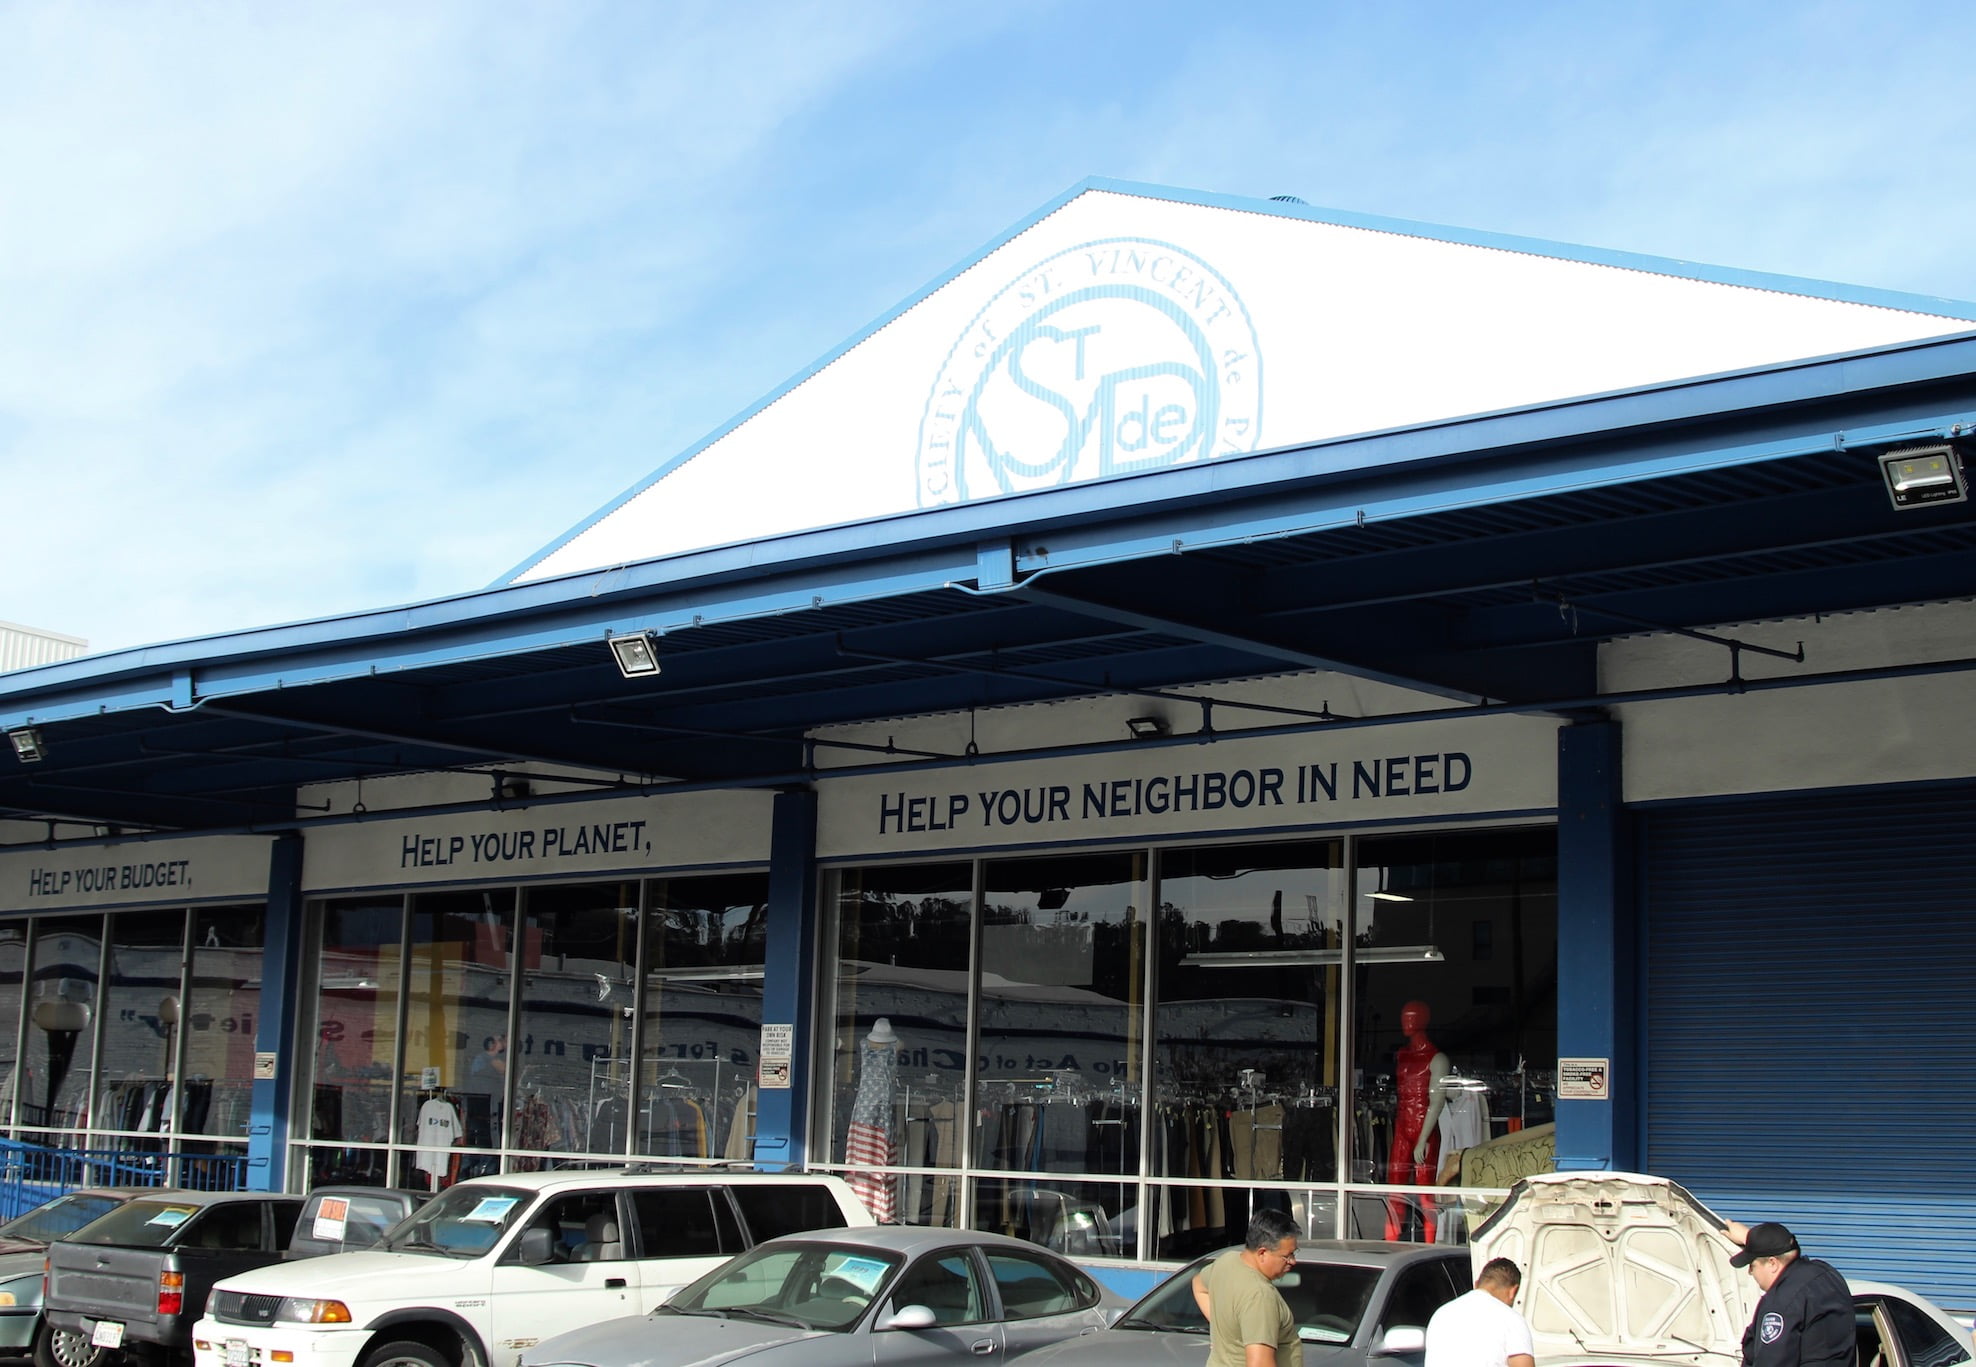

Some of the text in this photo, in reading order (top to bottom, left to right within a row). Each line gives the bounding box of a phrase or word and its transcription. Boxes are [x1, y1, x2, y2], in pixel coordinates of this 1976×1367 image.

[1086, 250, 1232, 326] VINCENT
[1116, 394, 1188, 453] de
[879, 751, 1472, 834] HELP YOUR NEIGHBOR IN NEED
[401, 820, 651, 868] HELP YOUR PLANET,
[29, 860, 192, 896] HELP YOUR BUDGET,
